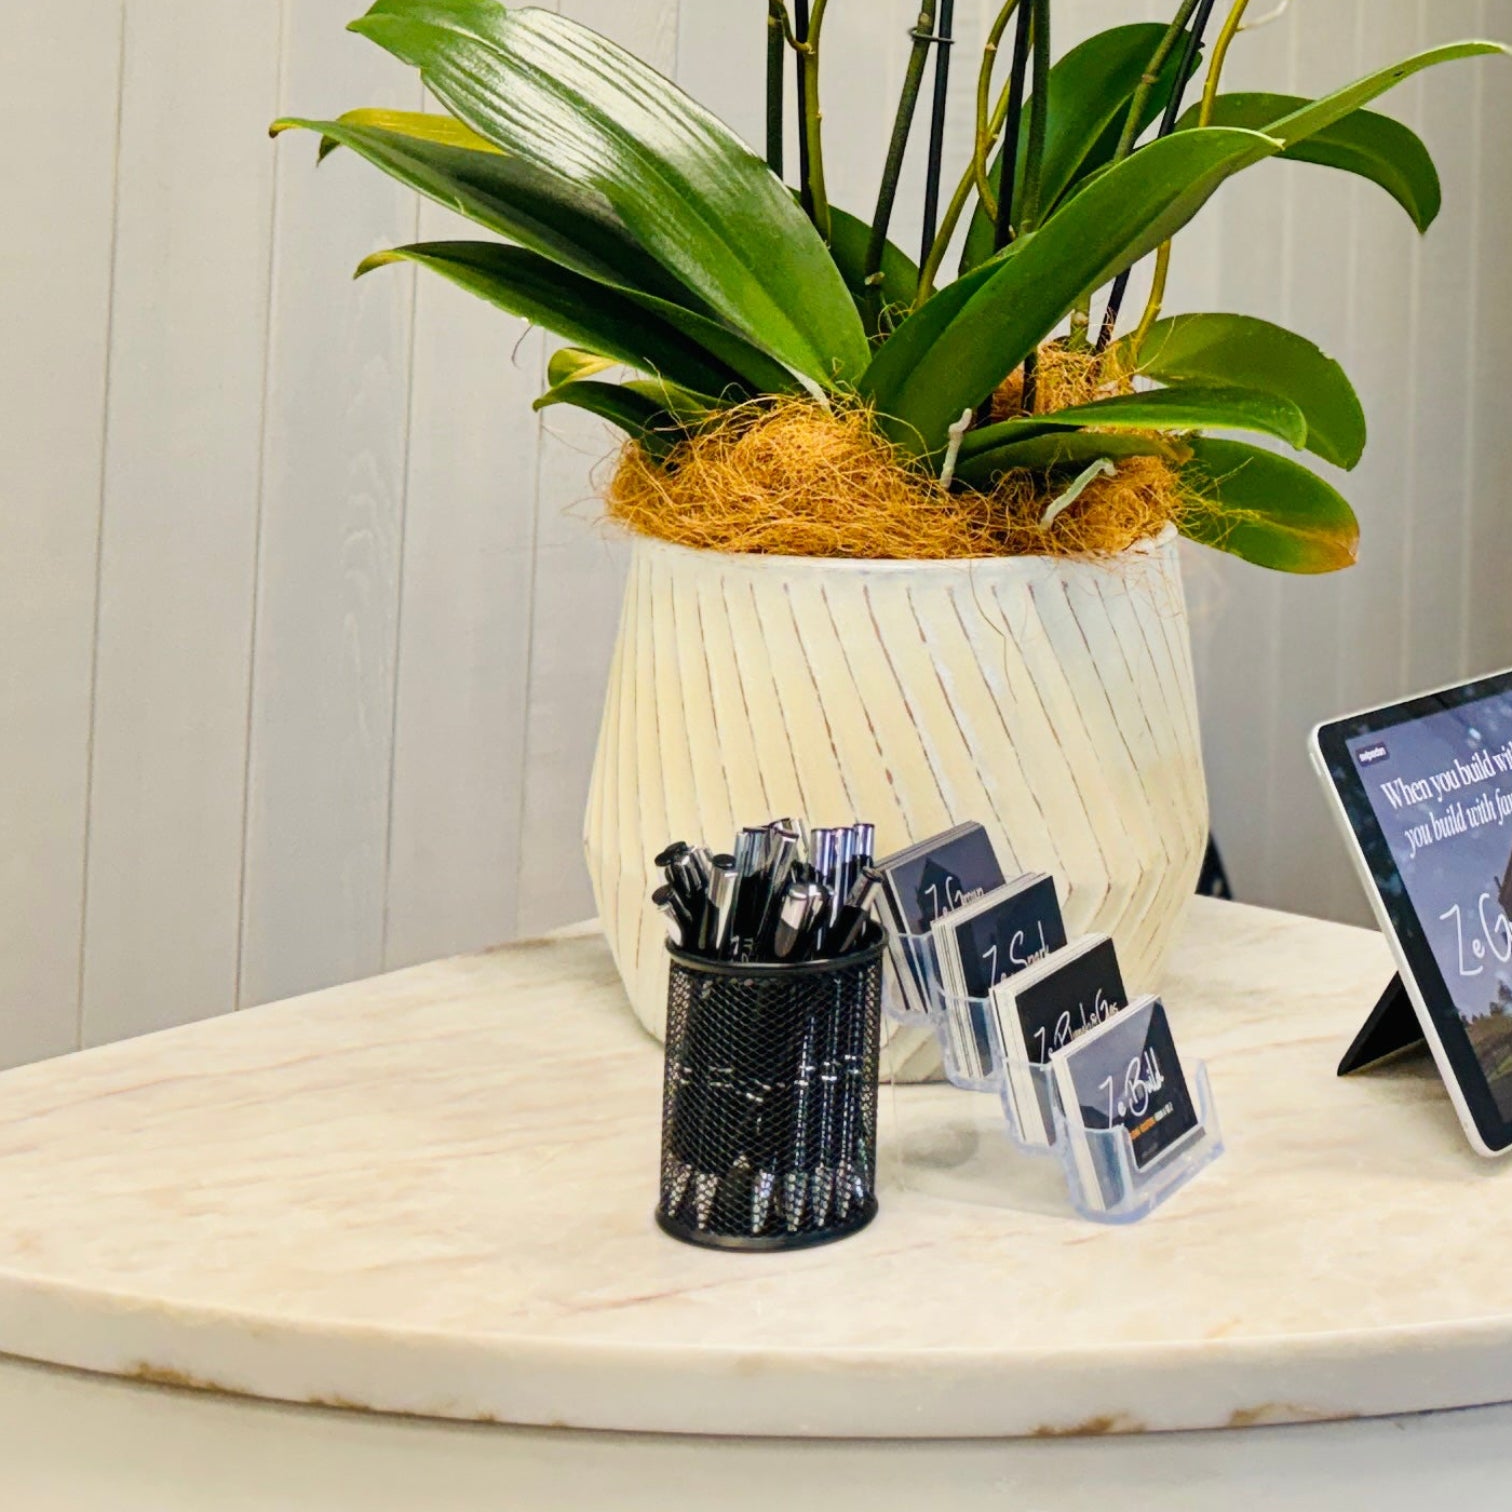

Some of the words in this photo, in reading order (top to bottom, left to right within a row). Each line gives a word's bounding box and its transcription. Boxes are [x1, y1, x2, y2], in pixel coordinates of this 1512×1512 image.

[1380, 777, 1432, 810] When
[1429, 768, 1461, 803] you
[1453, 749, 1497, 786] build
[1404, 823, 1433, 859] you
[1429, 802, 1467, 841] build
[1466, 793, 1498, 828] with
[1439, 903, 1486, 976] Ze
[1125, 1046, 1165, 1117] Build
